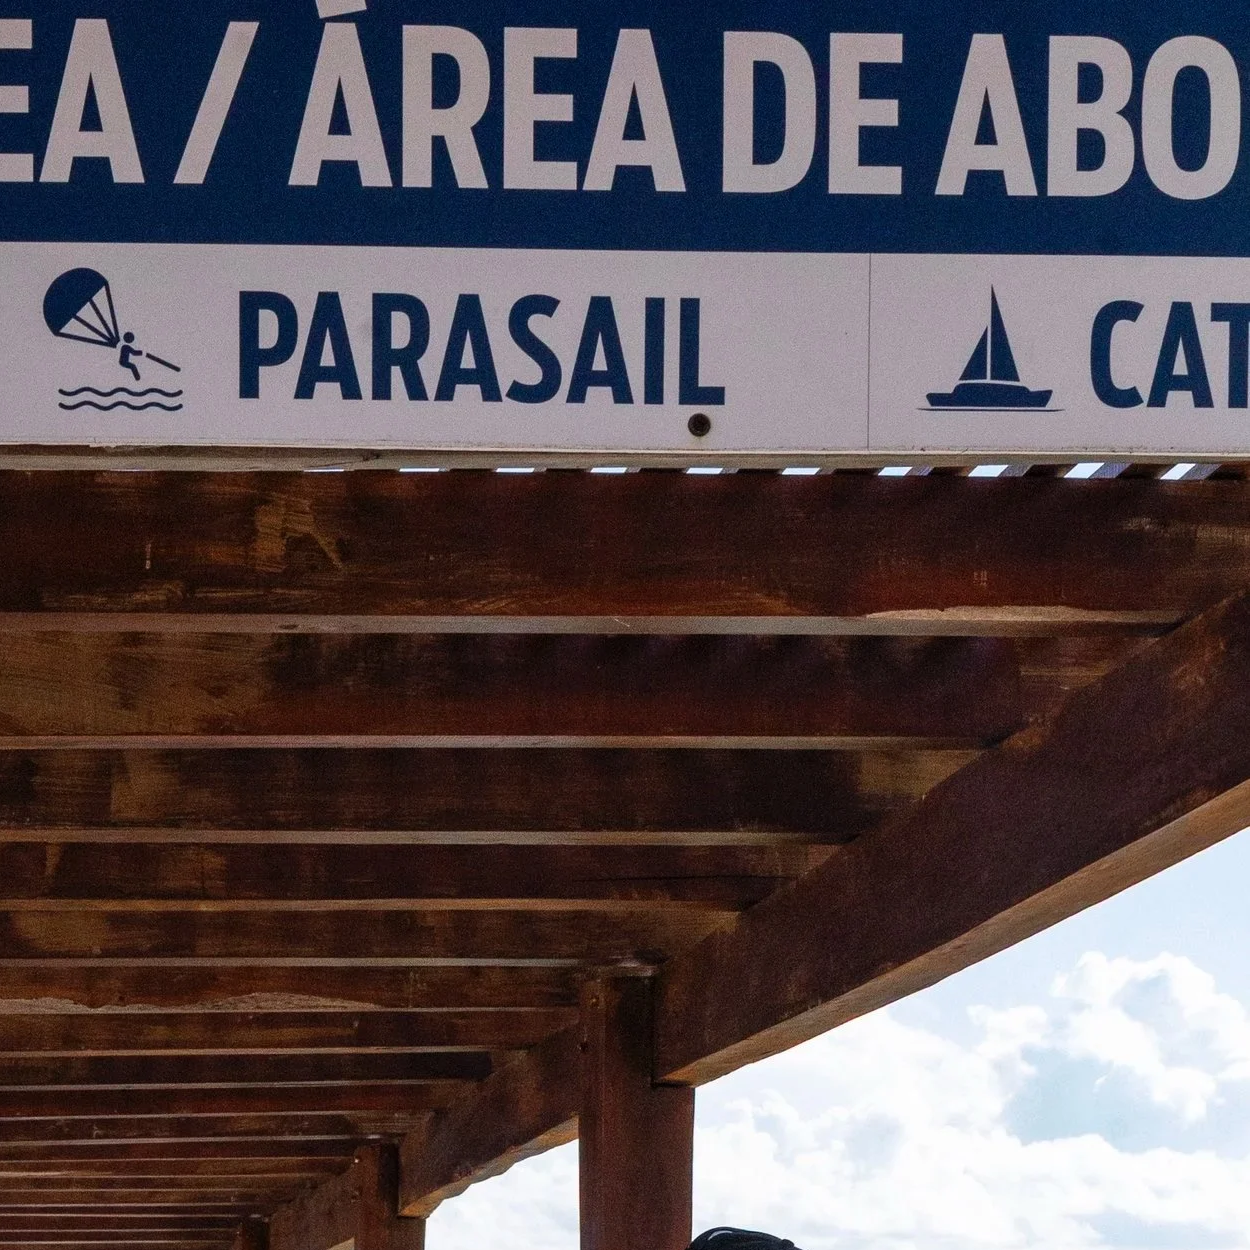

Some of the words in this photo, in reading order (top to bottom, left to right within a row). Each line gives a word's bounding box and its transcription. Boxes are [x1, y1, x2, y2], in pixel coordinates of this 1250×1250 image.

[173, 21, 259, 184] /
[288, 0, 687, 193] ÁREA
[723, 31, 903, 196] DE
[935, 34, 1242, 200] ABO
[239, 291, 726, 405] PARASAIL
[1091, 300, 1250, 408] CAT
